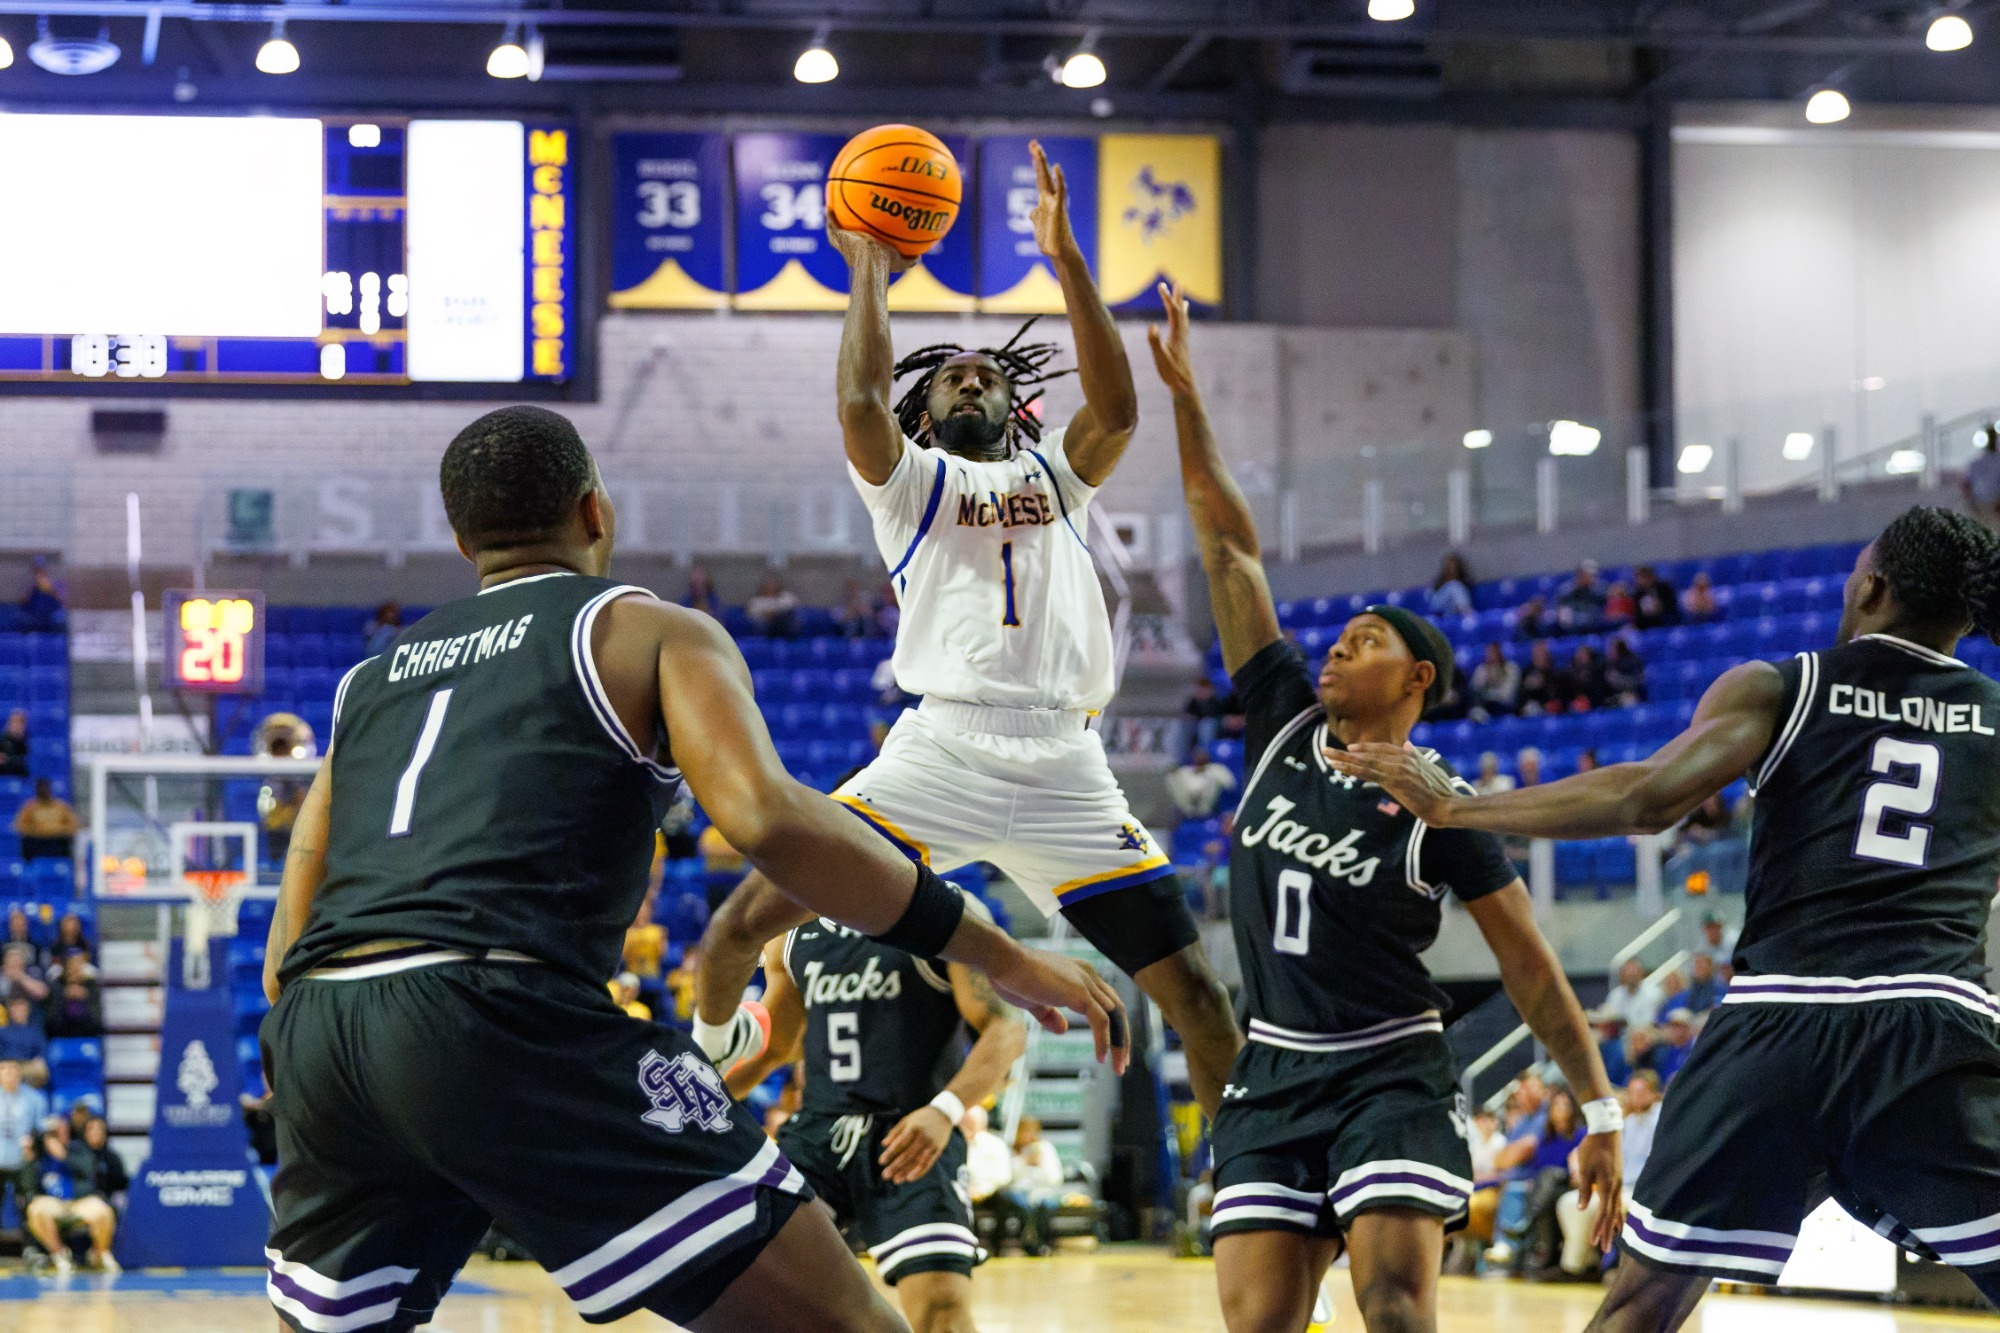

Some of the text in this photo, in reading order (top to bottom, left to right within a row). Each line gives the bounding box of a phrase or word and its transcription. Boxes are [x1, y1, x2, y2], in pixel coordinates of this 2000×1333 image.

[636, 180, 700, 229] 33
[760, 182, 824, 230] 34
[869, 191, 949, 232] Wilson
[956, 489, 1054, 528] McNESE
[1000, 540, 1022, 628] 1
[180, 631, 244, 682] 20
[388, 613, 534, 682] CHRISTMAS
[1829, 683, 1995, 736] COLONEL
[388, 686, 455, 837] 1
[1852, 735, 1944, 868] 2
[1241, 794, 1381, 886] Jacks
[1273, 868, 1313, 956] 0
[803, 955, 902, 1009] Jacks
[827, 1011, 862, 1083] 5
[640, 1055, 731, 1130] SFA
